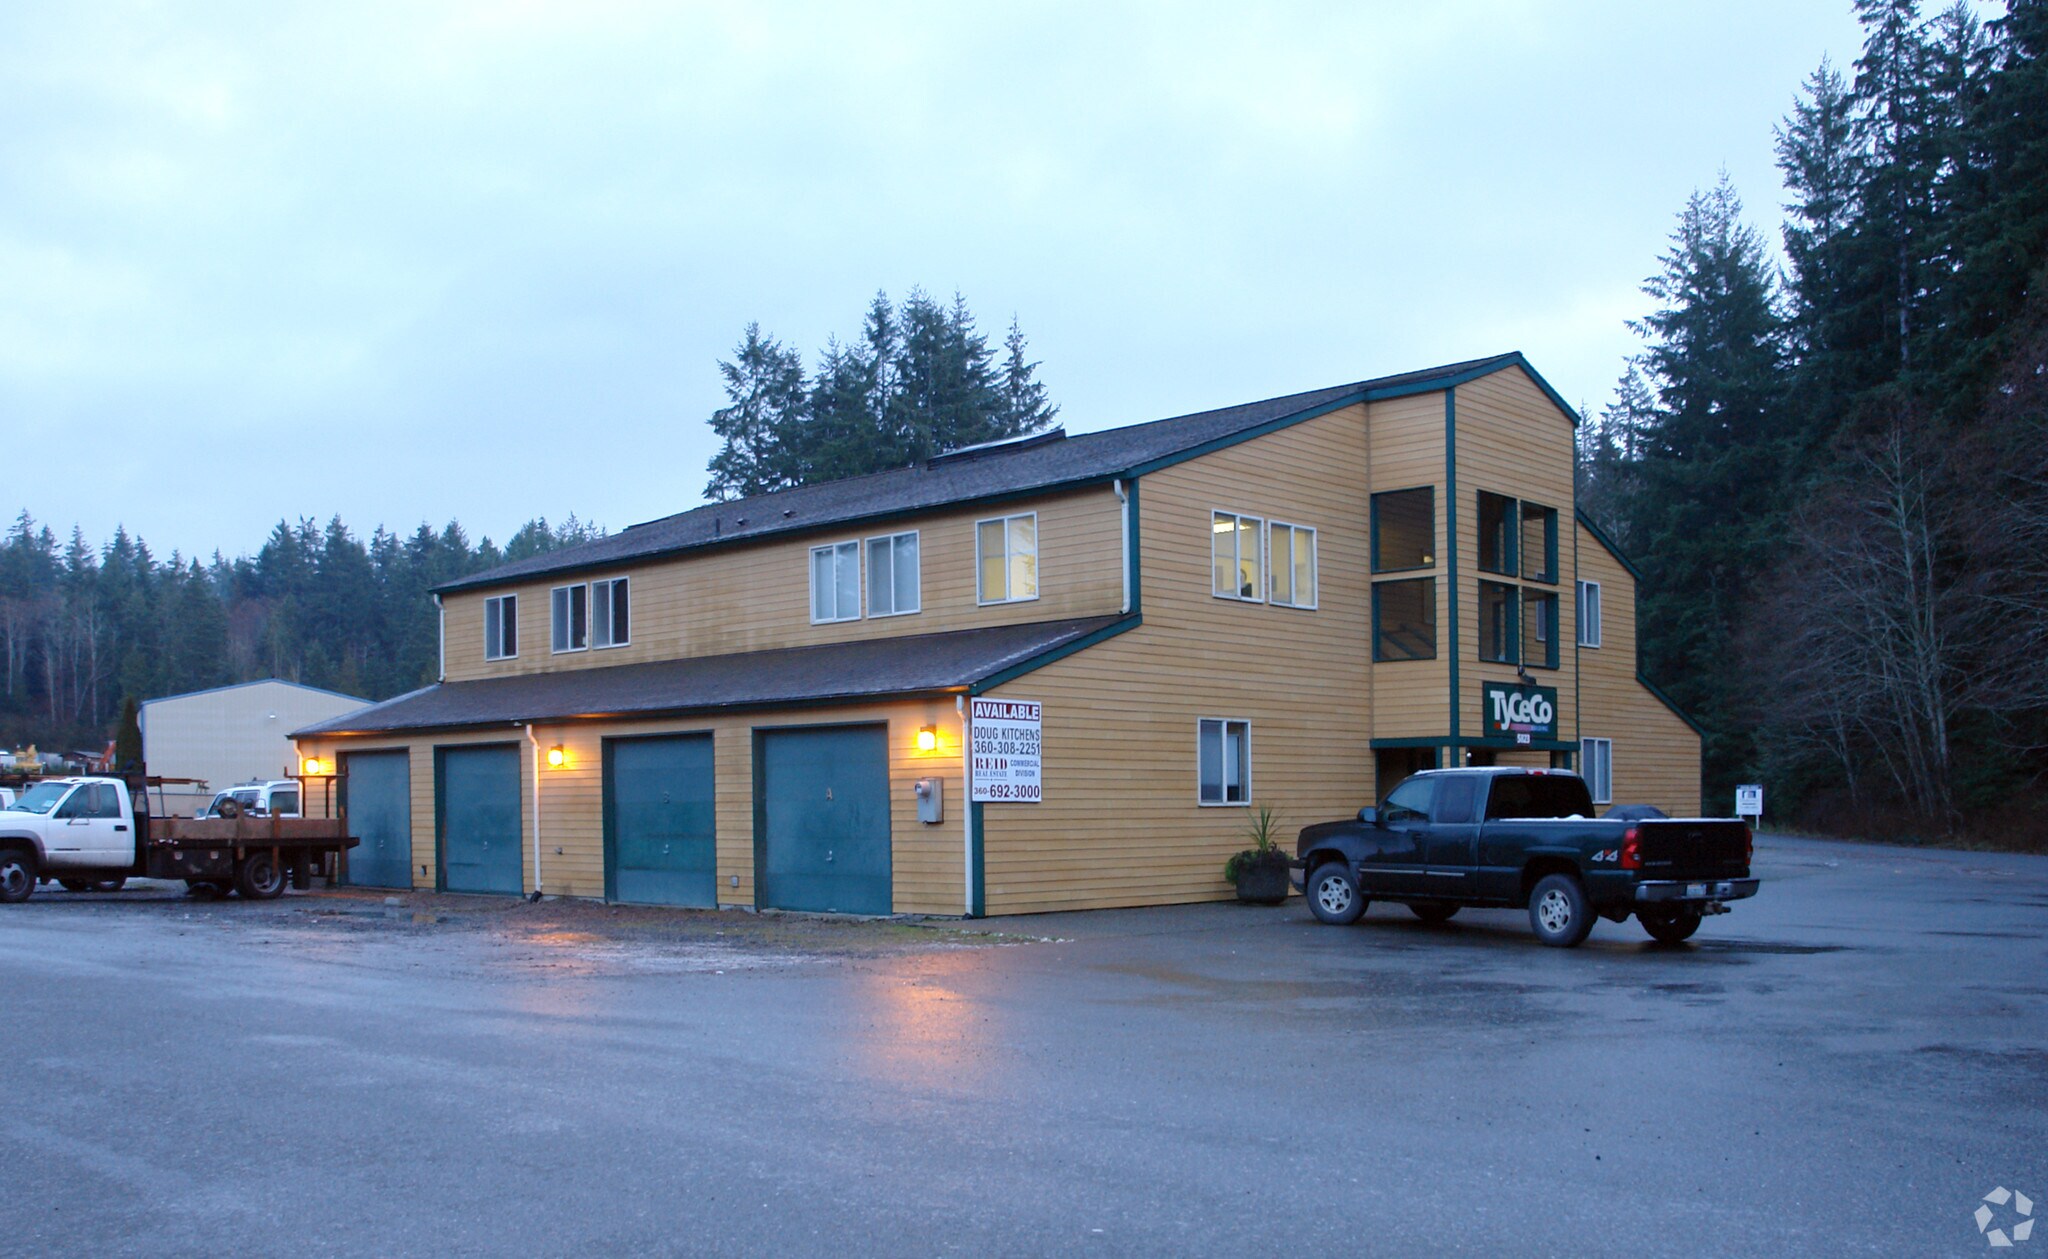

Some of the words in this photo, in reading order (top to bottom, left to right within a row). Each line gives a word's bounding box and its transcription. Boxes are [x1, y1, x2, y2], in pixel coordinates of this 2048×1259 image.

[975, 702, 1039, 720] AVAILABLE
[974, 726, 998, 740] DOUG
[1001, 728, 1040, 741] KITCHENS
[974, 741, 1040, 755] 360-308-2251
[975, 758, 1007, 770] REID
[1010, 759, 1040, 768] COMMERCIAL
[1015, 769, 1036, 777] DIVISION
